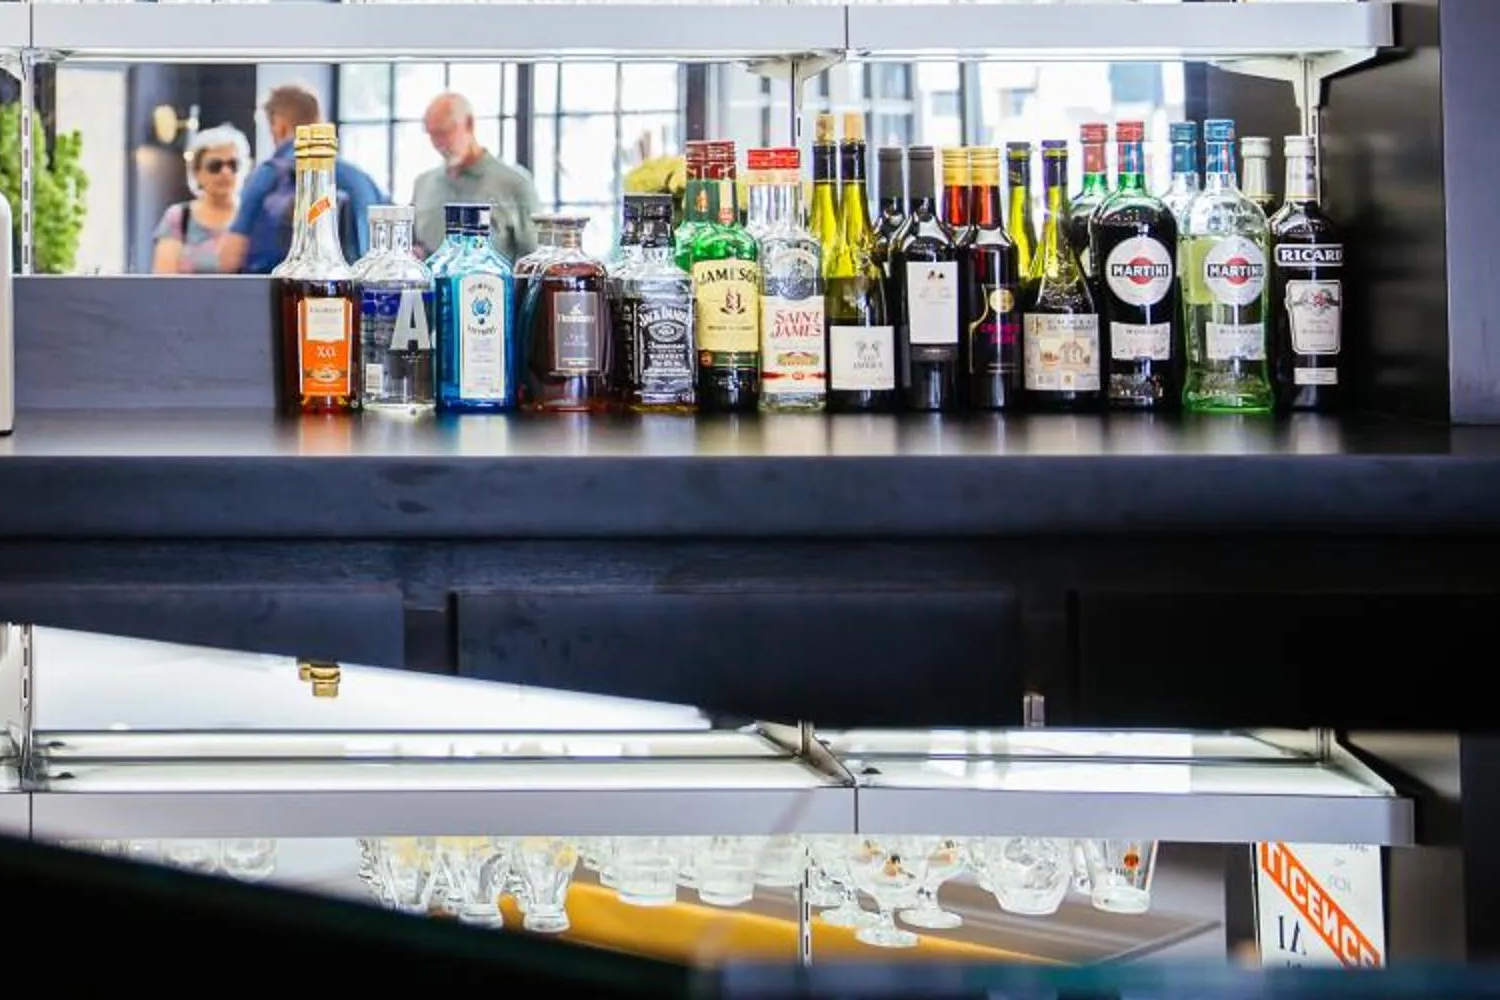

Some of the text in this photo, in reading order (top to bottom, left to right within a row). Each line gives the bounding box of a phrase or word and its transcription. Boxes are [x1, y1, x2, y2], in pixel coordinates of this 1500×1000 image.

[1113, 265, 1168, 277] MARTINI
[775, 311, 821, 323] SAINT
[771, 322, 821, 338] JAMES
